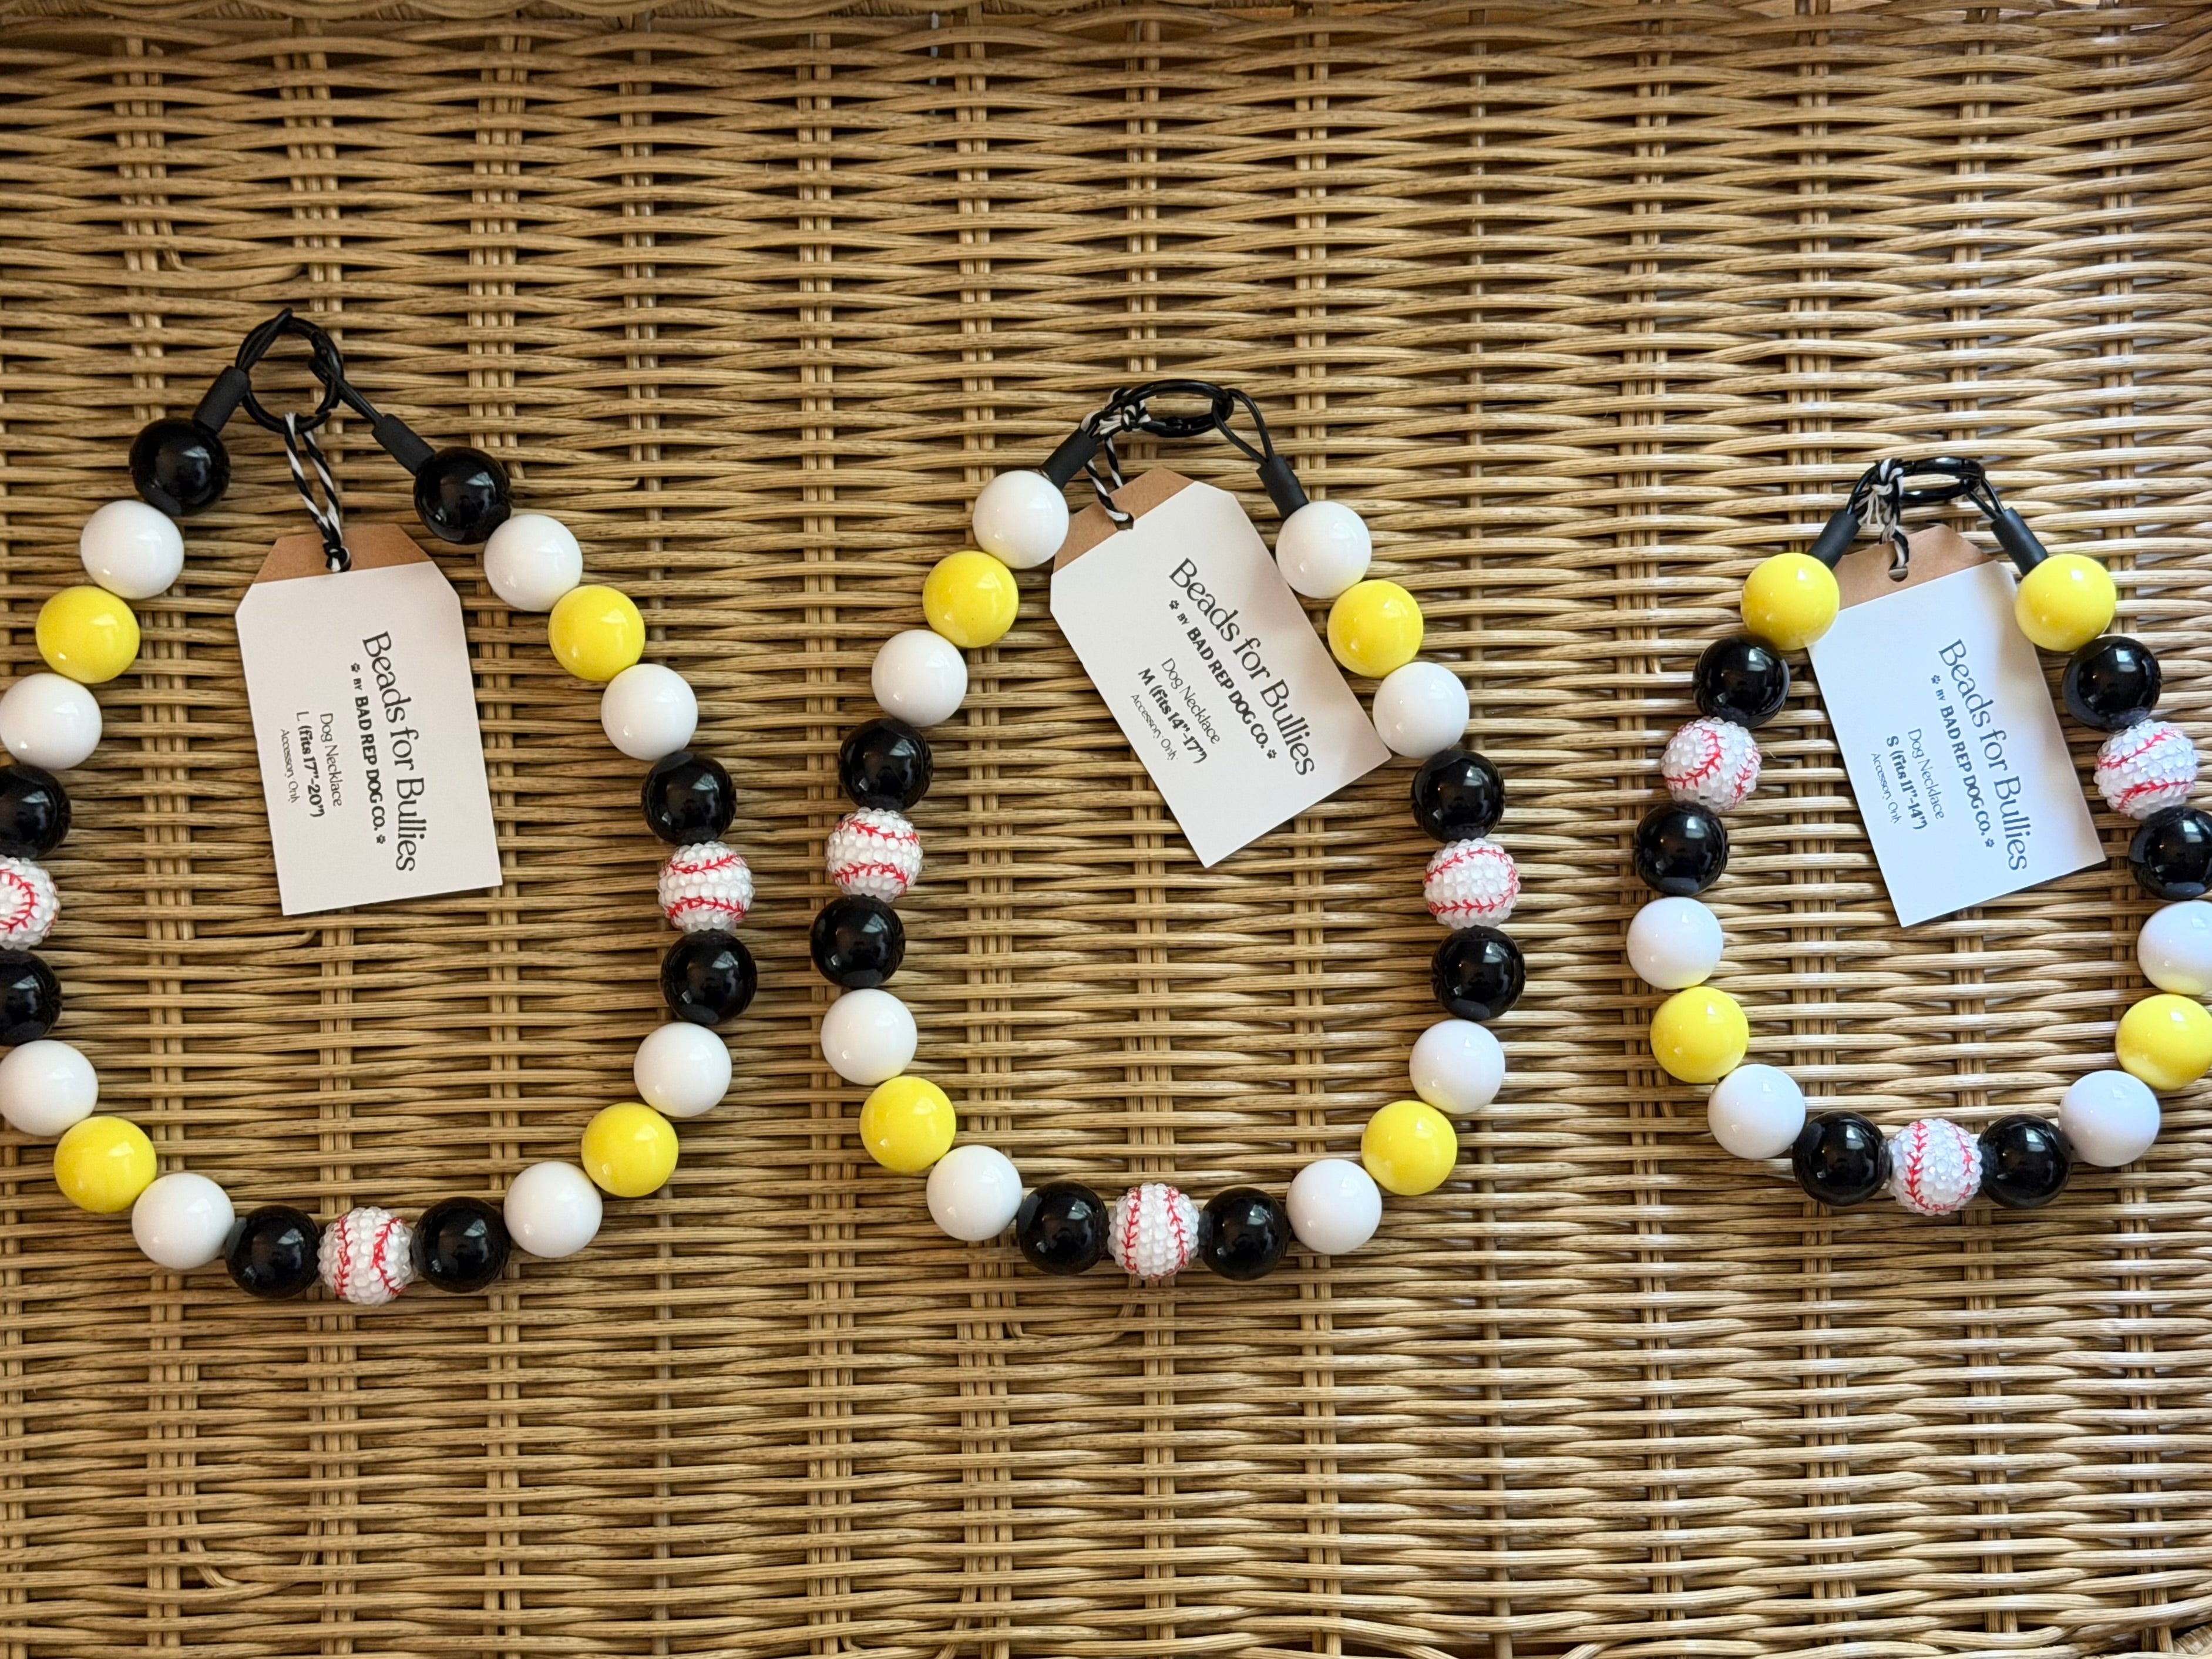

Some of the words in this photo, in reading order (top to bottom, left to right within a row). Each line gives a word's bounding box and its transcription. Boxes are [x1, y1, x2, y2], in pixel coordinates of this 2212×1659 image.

[352, 677, 363, 691] BY
[362, 631, 412, 724] Beads
[1168, 557, 1241, 642] Beads
[1232, 637, 1270, 680] for
[1259, 679, 1315, 776] Bullies
[1176, 613, 1190, 625] BY
[1186, 627, 1214, 661] BAD
[1208, 659, 1235, 689] REP
[1228, 690, 1256, 725] DOG
[1250, 723, 1269, 749] CO.
[1138, 667, 1155, 687] M
[1148, 685, 1172, 715] (fits
[1161, 658, 1183, 689] Dog
[1179, 685, 1220, 745] Necklace
[1935, 689, 1946, 701] BY
[296, 711, 310, 722] L
[320, 712, 334, 743] Dog
[355, 695, 372, 731] BAD
[1940, 705, 1961, 740] BAD
[298, 725, 312, 755] (fits
[360, 733, 378, 765] REP
[389, 726, 419, 771] for
[1886, 735, 1899, 747] S
[1938, 638, 1994, 728] Beads
[1979, 728, 2008, 772] for
[1994, 775, 2031, 871] Bullies
[1952, 741, 1972, 773] REP
[325, 744, 342, 807] Necklace
[1889, 750, 1907, 780] (fits
[1907, 728, 1924, 759] Dog
[1918, 759, 1945, 819] Necklace
[365, 768, 383, 804] DOG
[1963, 774, 1984, 810] DOG
[371, 806, 385, 832] CO.
[395, 777, 428, 871] Bullies
[1975, 810, 1991, 836] CO.
